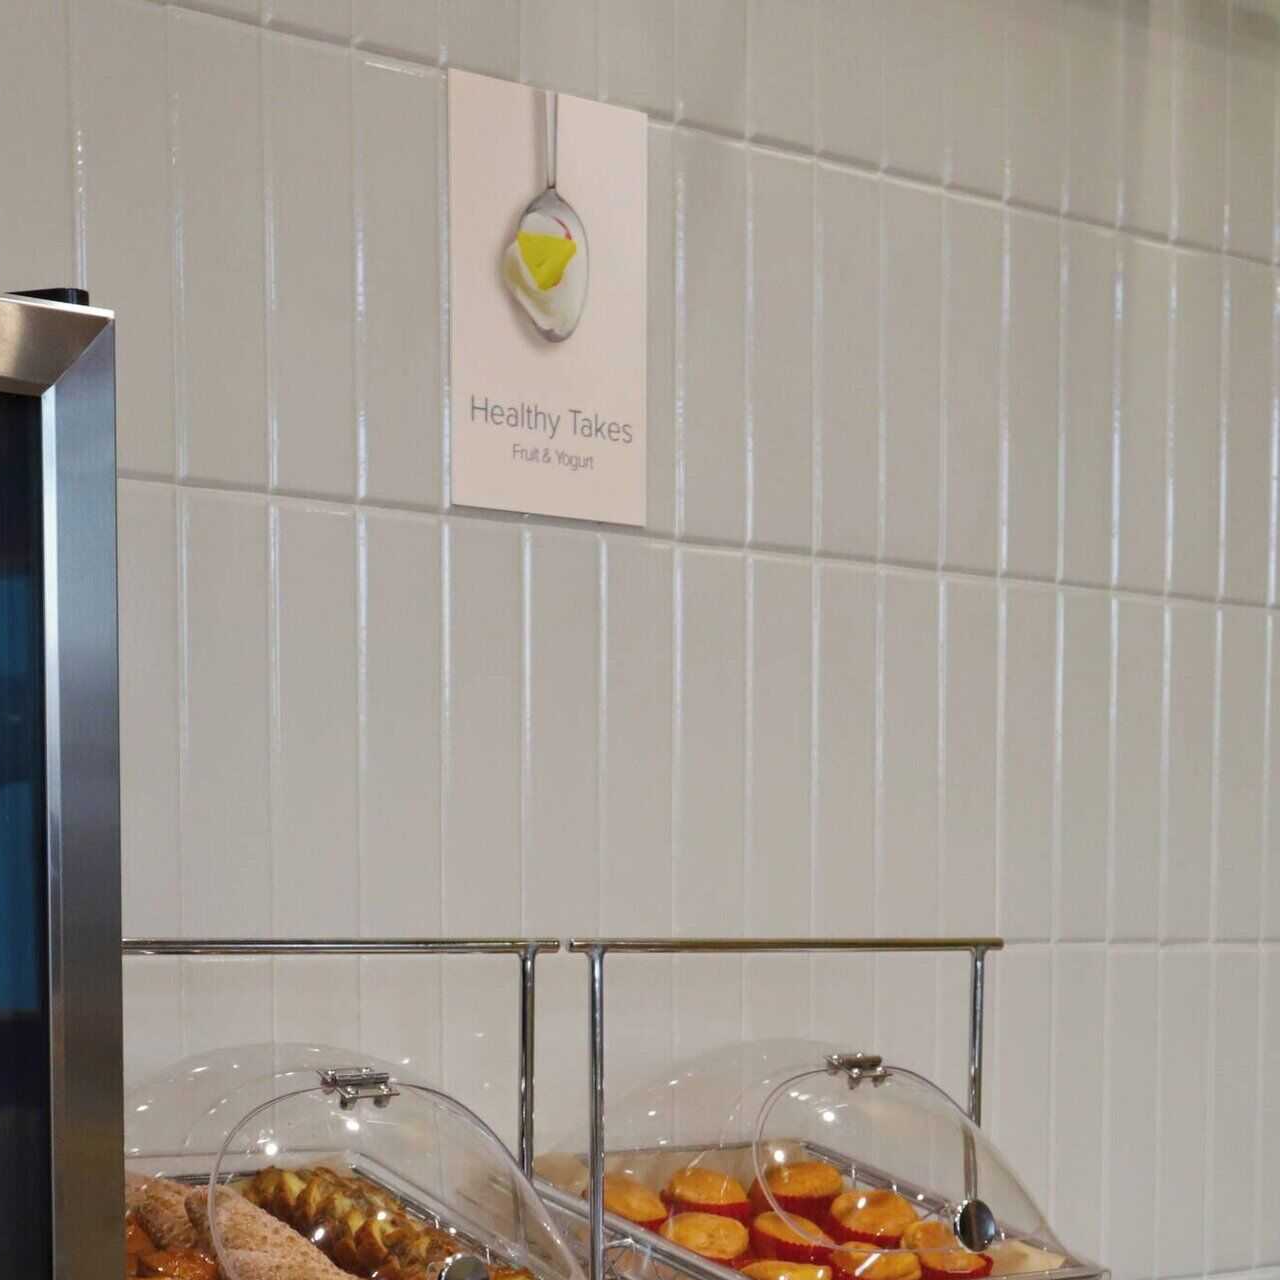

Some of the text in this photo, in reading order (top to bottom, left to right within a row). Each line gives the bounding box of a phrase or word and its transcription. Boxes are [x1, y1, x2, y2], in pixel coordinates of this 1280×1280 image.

[470, 395, 633, 444] Healthy Takes
[512, 443, 594, 471] Fruit & Yogurt
